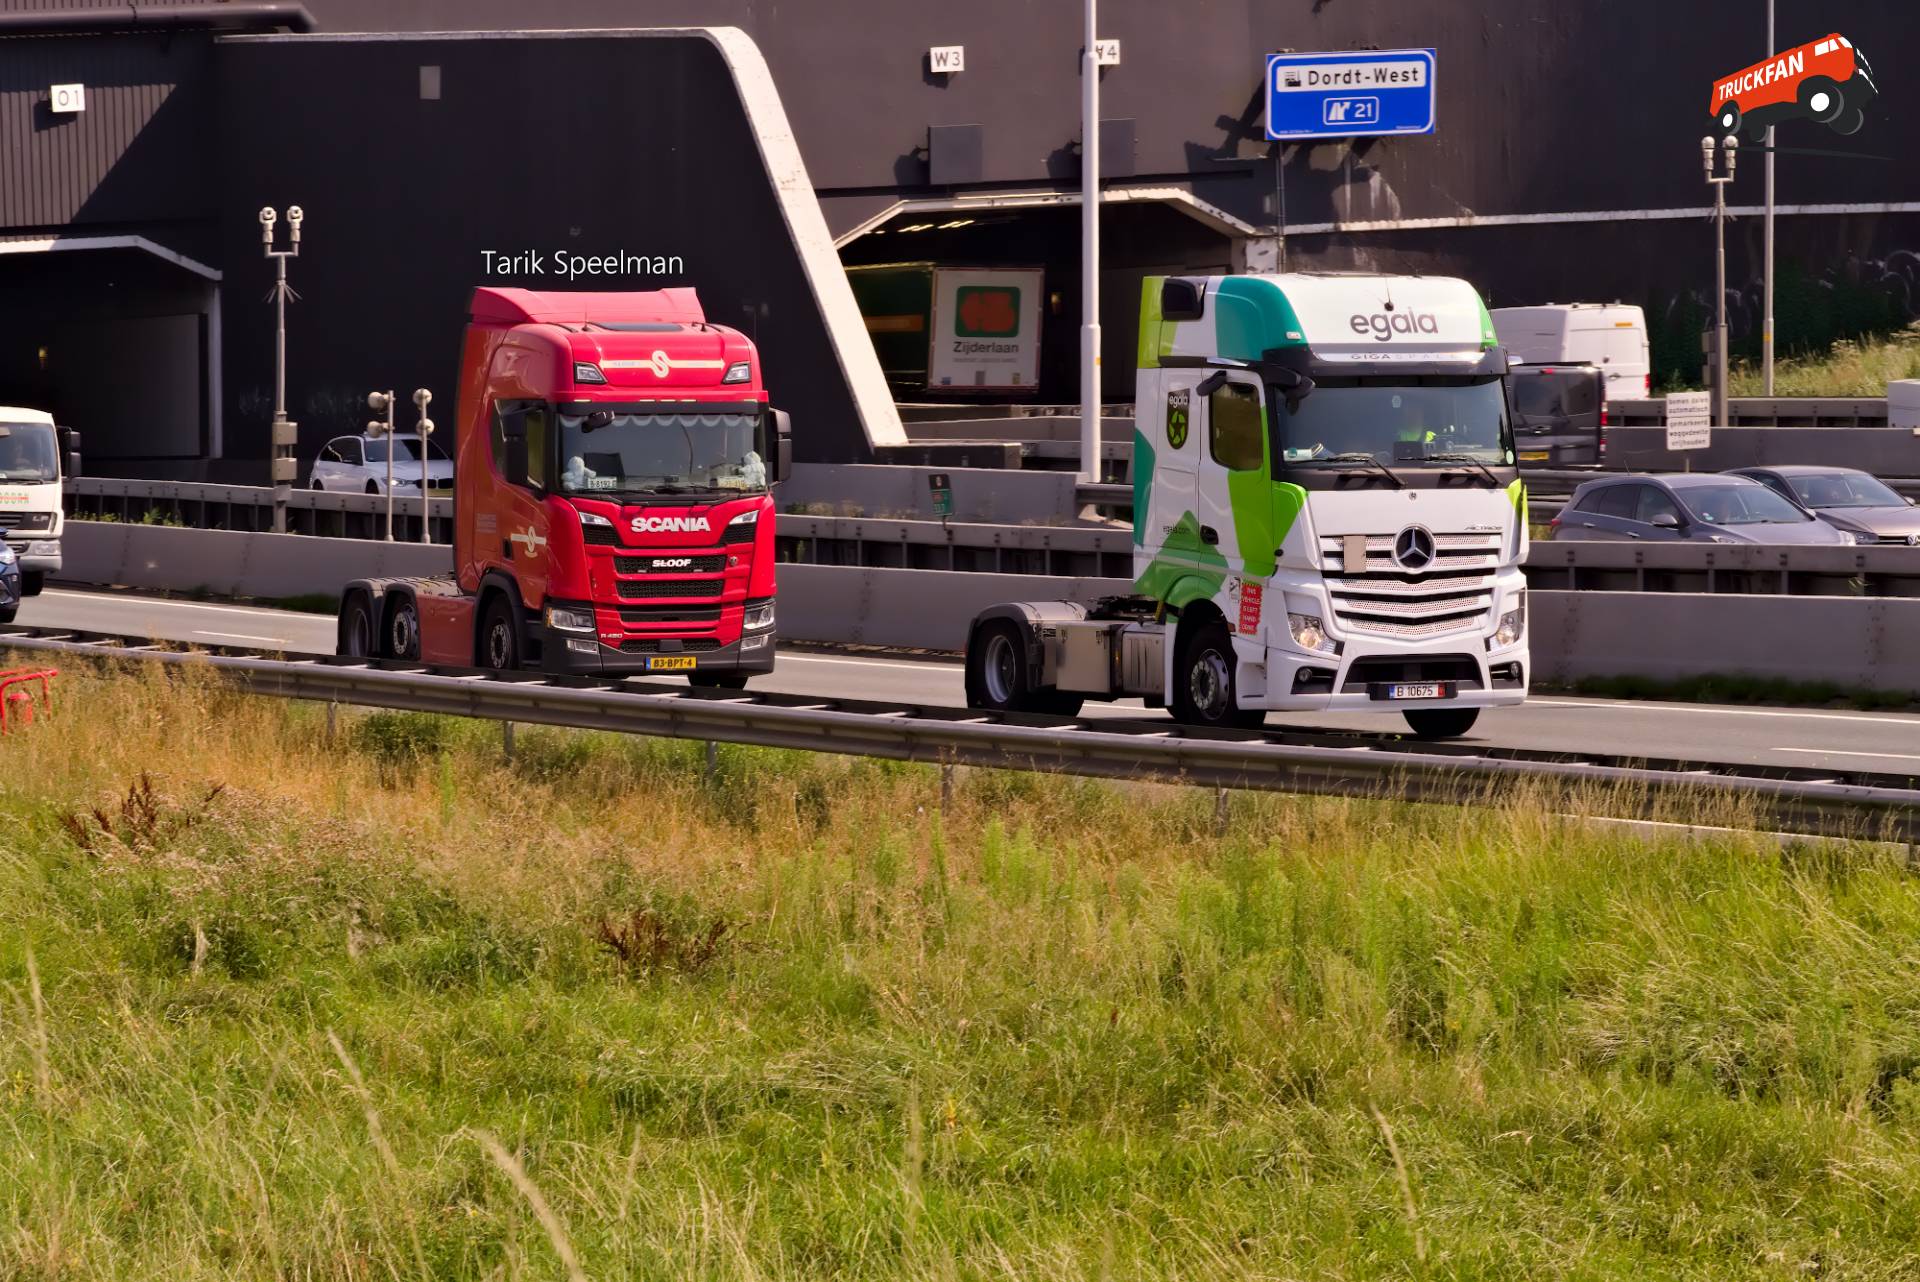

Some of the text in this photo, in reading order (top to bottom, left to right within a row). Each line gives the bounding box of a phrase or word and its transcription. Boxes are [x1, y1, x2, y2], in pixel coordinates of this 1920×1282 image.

[934, 51, 961, 67] W3
[1308, 67, 1419, 86] Dordt-West
[1354, 103, 1373, 118] 21
[631, 516, 711, 532] SCANIA
[1407, 686, 1433, 697] 10675
